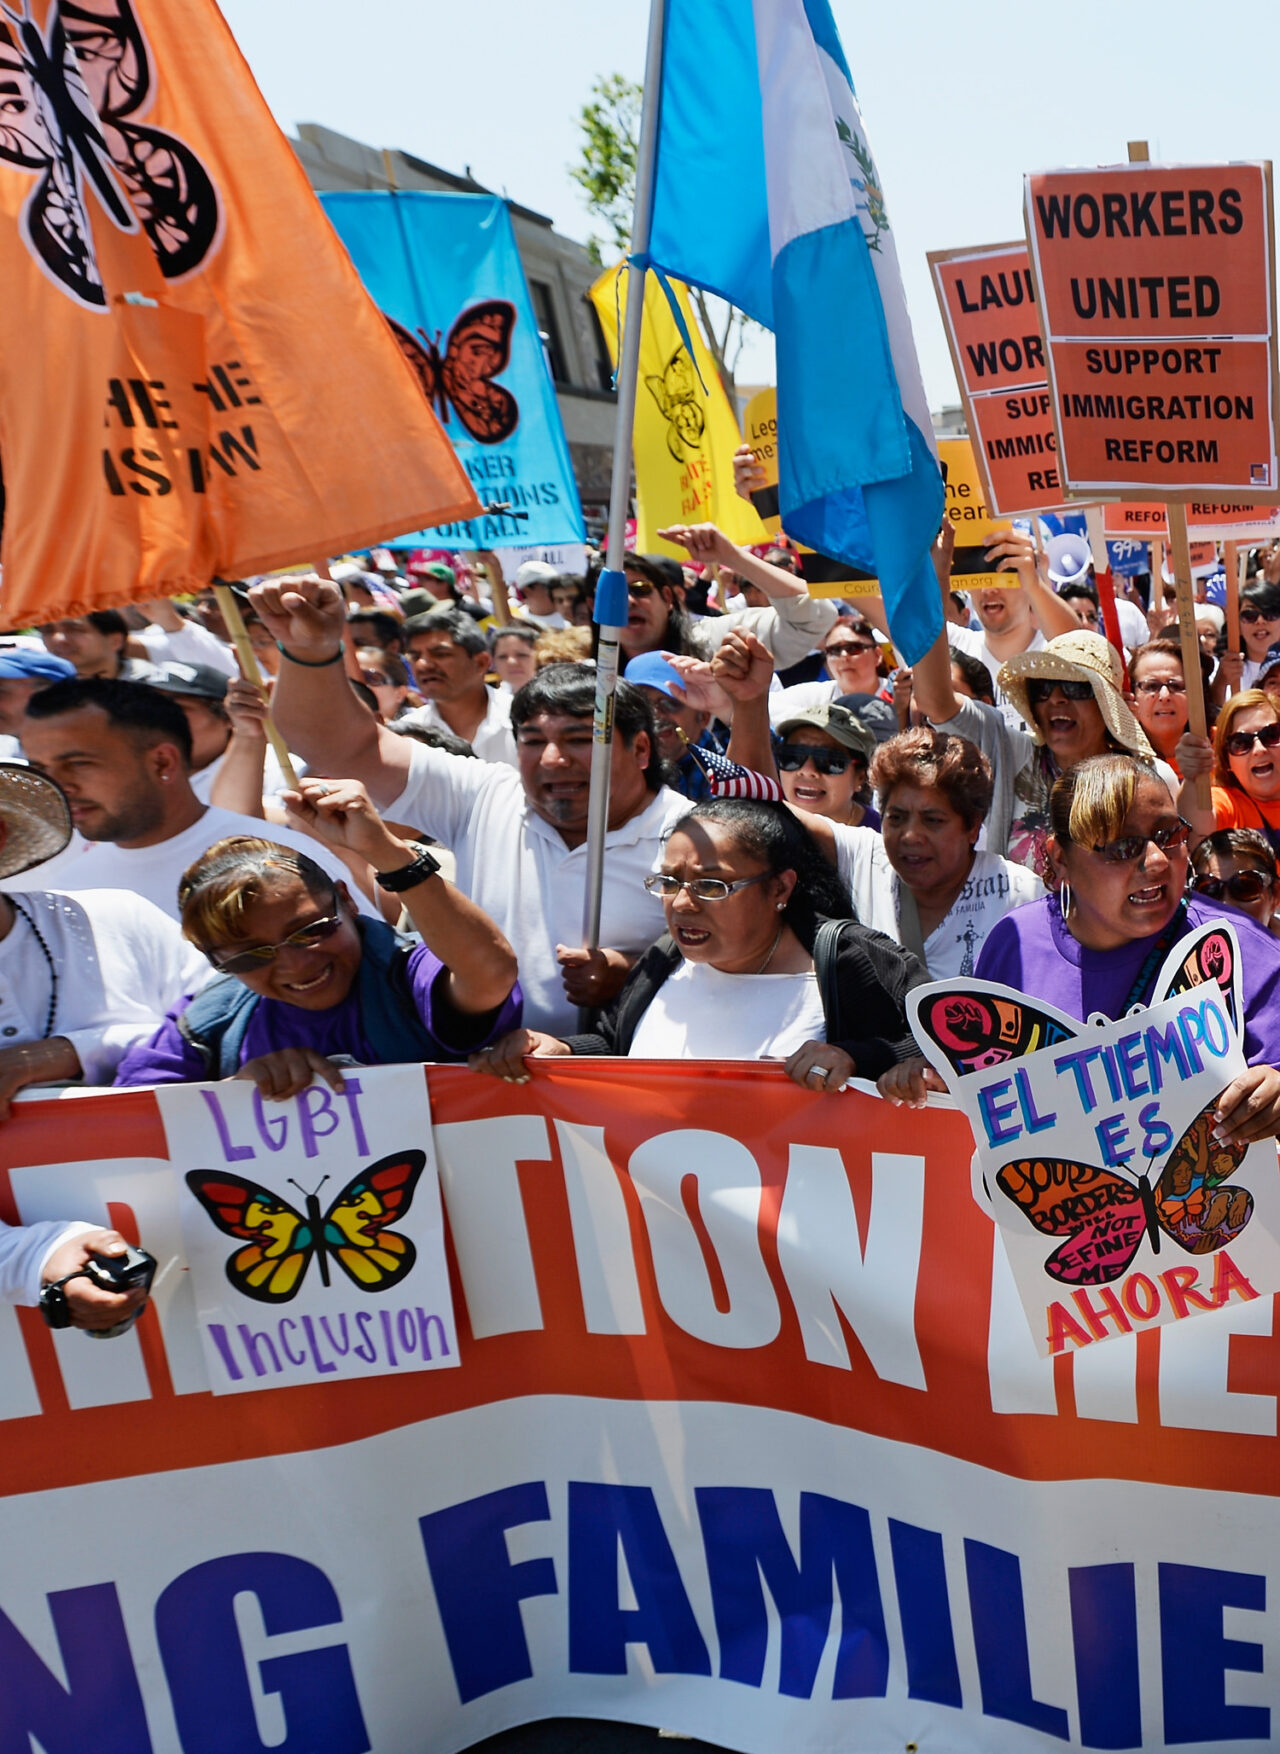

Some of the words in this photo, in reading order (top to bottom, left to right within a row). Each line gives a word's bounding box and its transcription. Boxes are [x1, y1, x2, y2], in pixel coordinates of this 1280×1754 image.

[1036, 187, 1244, 240] WORKERS
[1070, 275, 1221, 320] UNITED
[966, 334, 1045, 378] WOR
[1085, 347, 1222, 375] SUPPORT
[1006, 393, 1051, 420] SUP
[1062, 394, 1255, 421] IMMIGRATION
[751, 418, 778, 440] Leg
[986, 431, 1057, 461] IMMIG
[1104, 437, 1219, 464] REFORM
[464, 455, 516, 481] KER
[1028, 469, 1060, 491] RE
[478, 482, 560, 508] TIONS
[950, 575, 993, 588] gn.org
[976, 1066, 1058, 1150] EL
[1053, 997, 1230, 1114] TIEMPO
[201, 1077, 371, 1162] LGBT
[1094, 1102, 1174, 1169] ES
[999, 1159, 1101, 1207] YOUR
[1032, 1183, 1139, 1234] BORDERS
[1090, 1215, 1141, 1241] NOT
[1048, 1232, 1140, 1275] DEFINE
[1046, 1250, 1262, 1355] AHORA
